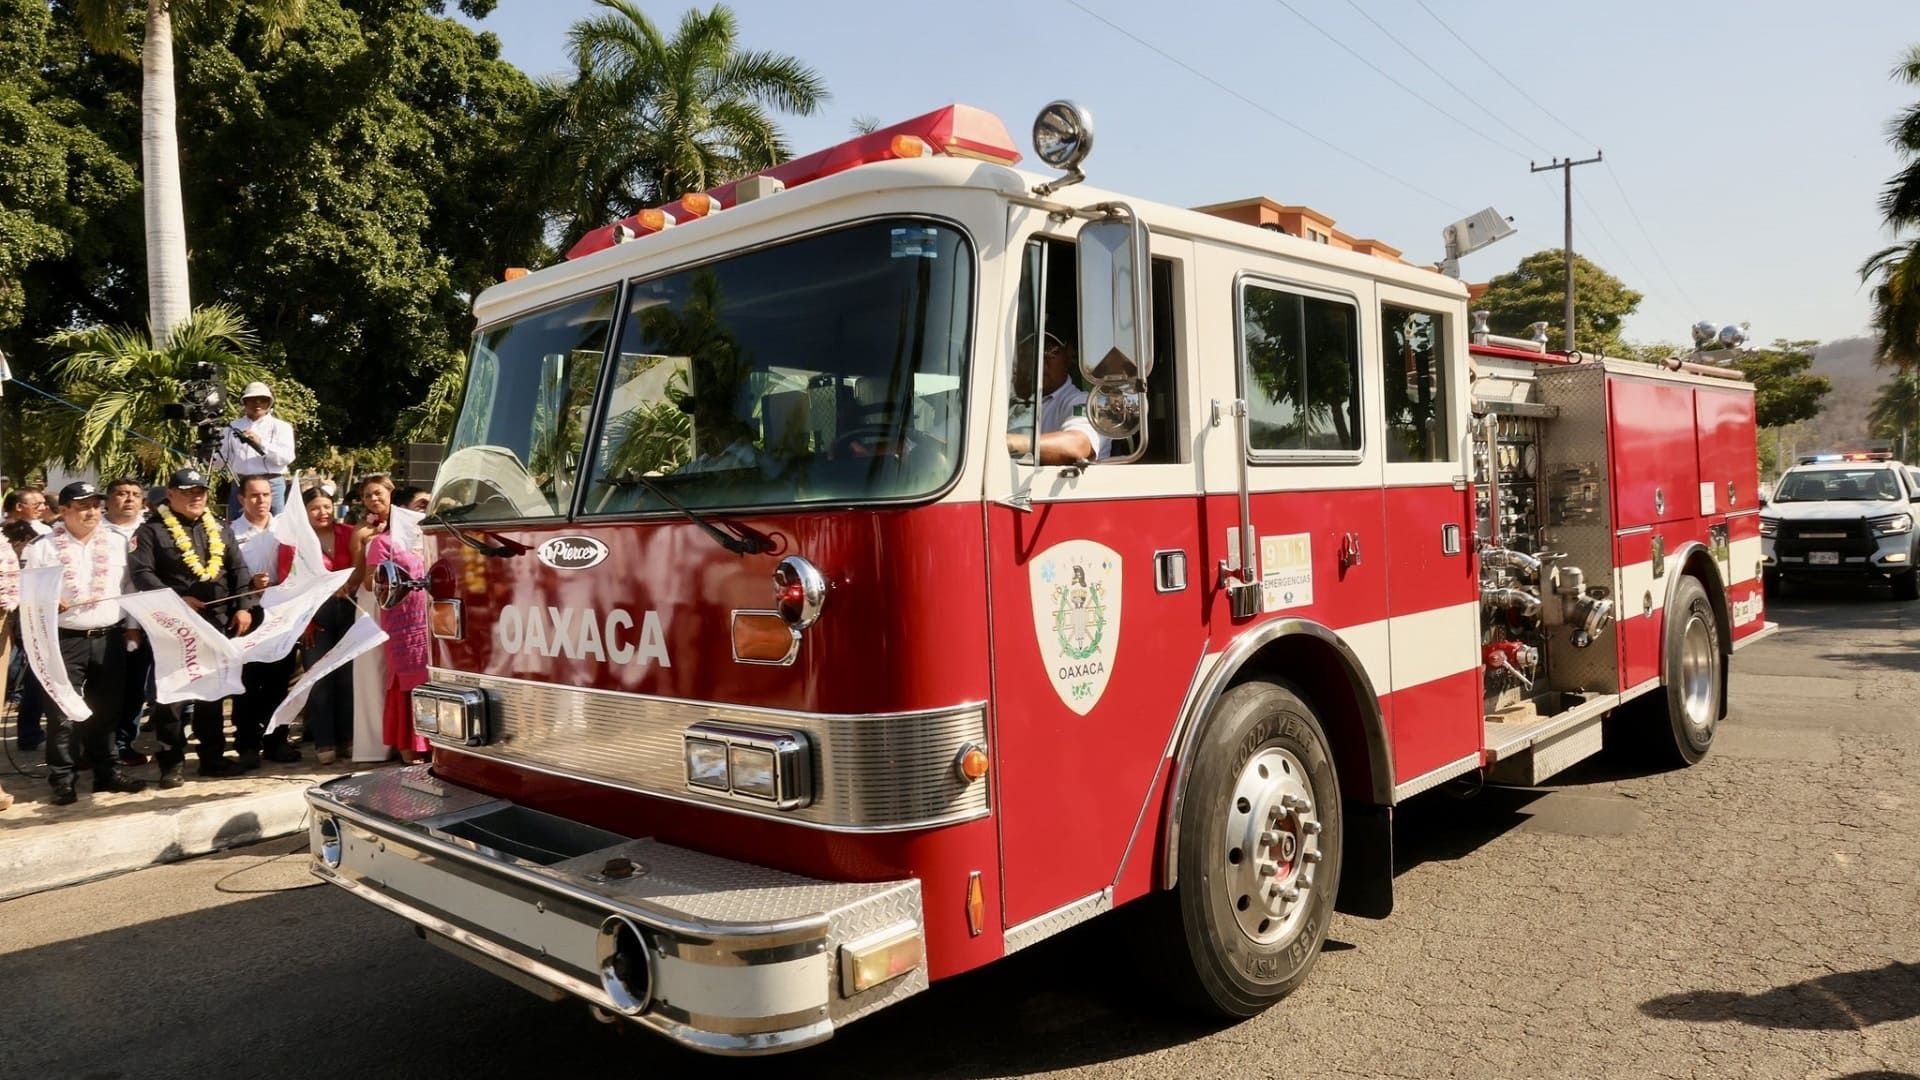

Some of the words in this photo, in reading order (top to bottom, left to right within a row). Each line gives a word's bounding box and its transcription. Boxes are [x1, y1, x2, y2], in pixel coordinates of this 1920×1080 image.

[552, 540, 594, 564] Pierce
[1263, 574, 1311, 589] EMERGENCIAS
[499, 604, 672, 668] OAXACA
[177, 626, 203, 683] OAXACA
[1058, 662, 1105, 680] OAXACA
